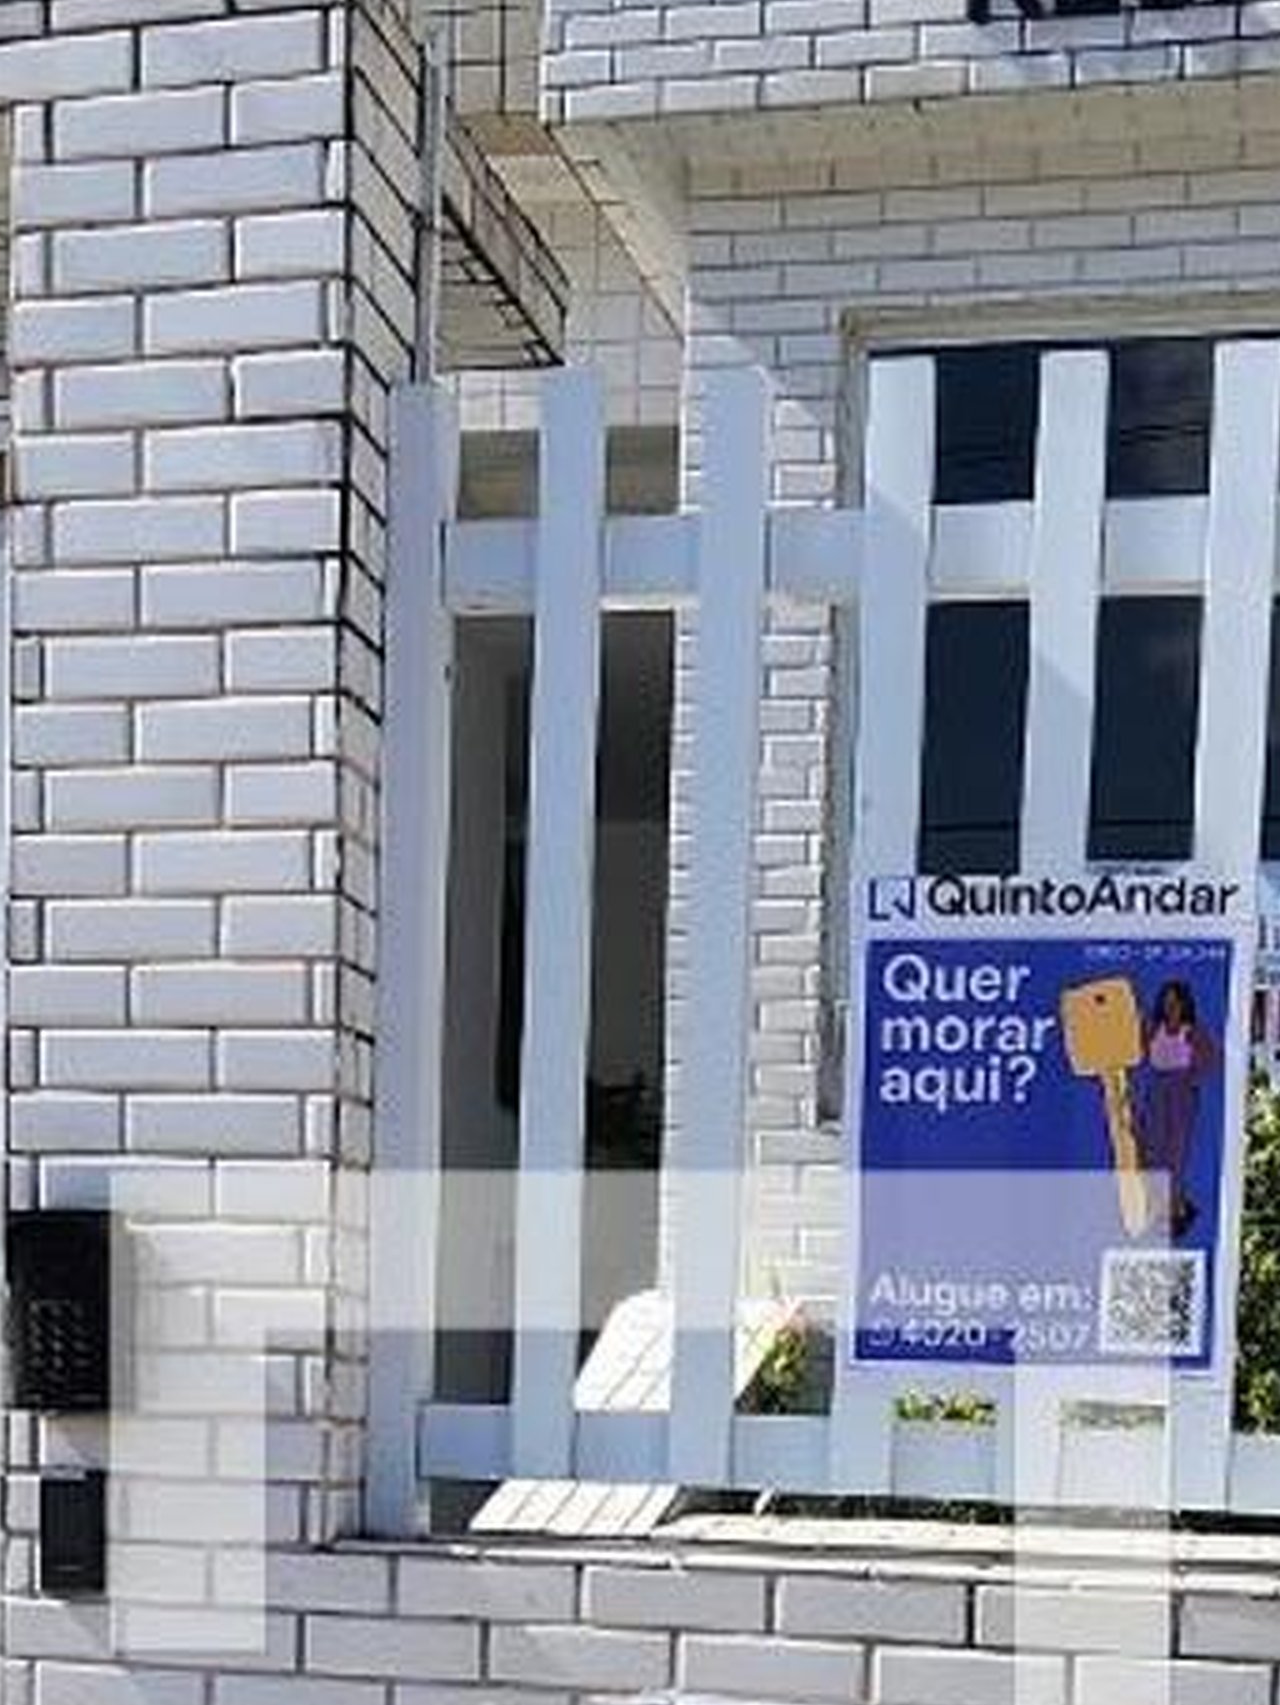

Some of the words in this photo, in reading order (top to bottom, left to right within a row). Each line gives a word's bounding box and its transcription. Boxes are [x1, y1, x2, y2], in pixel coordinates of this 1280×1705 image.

[927, 874, 1239, 917] QuintoAndar
[882, 953, 1031, 1002] Quer
[879, 1013, 1056, 1052] morar
[879, 1056, 1038, 1113] aqui?
[869, 1272, 1010, 1316] Alugue
[1019, 1281, 1095, 1311] em:
